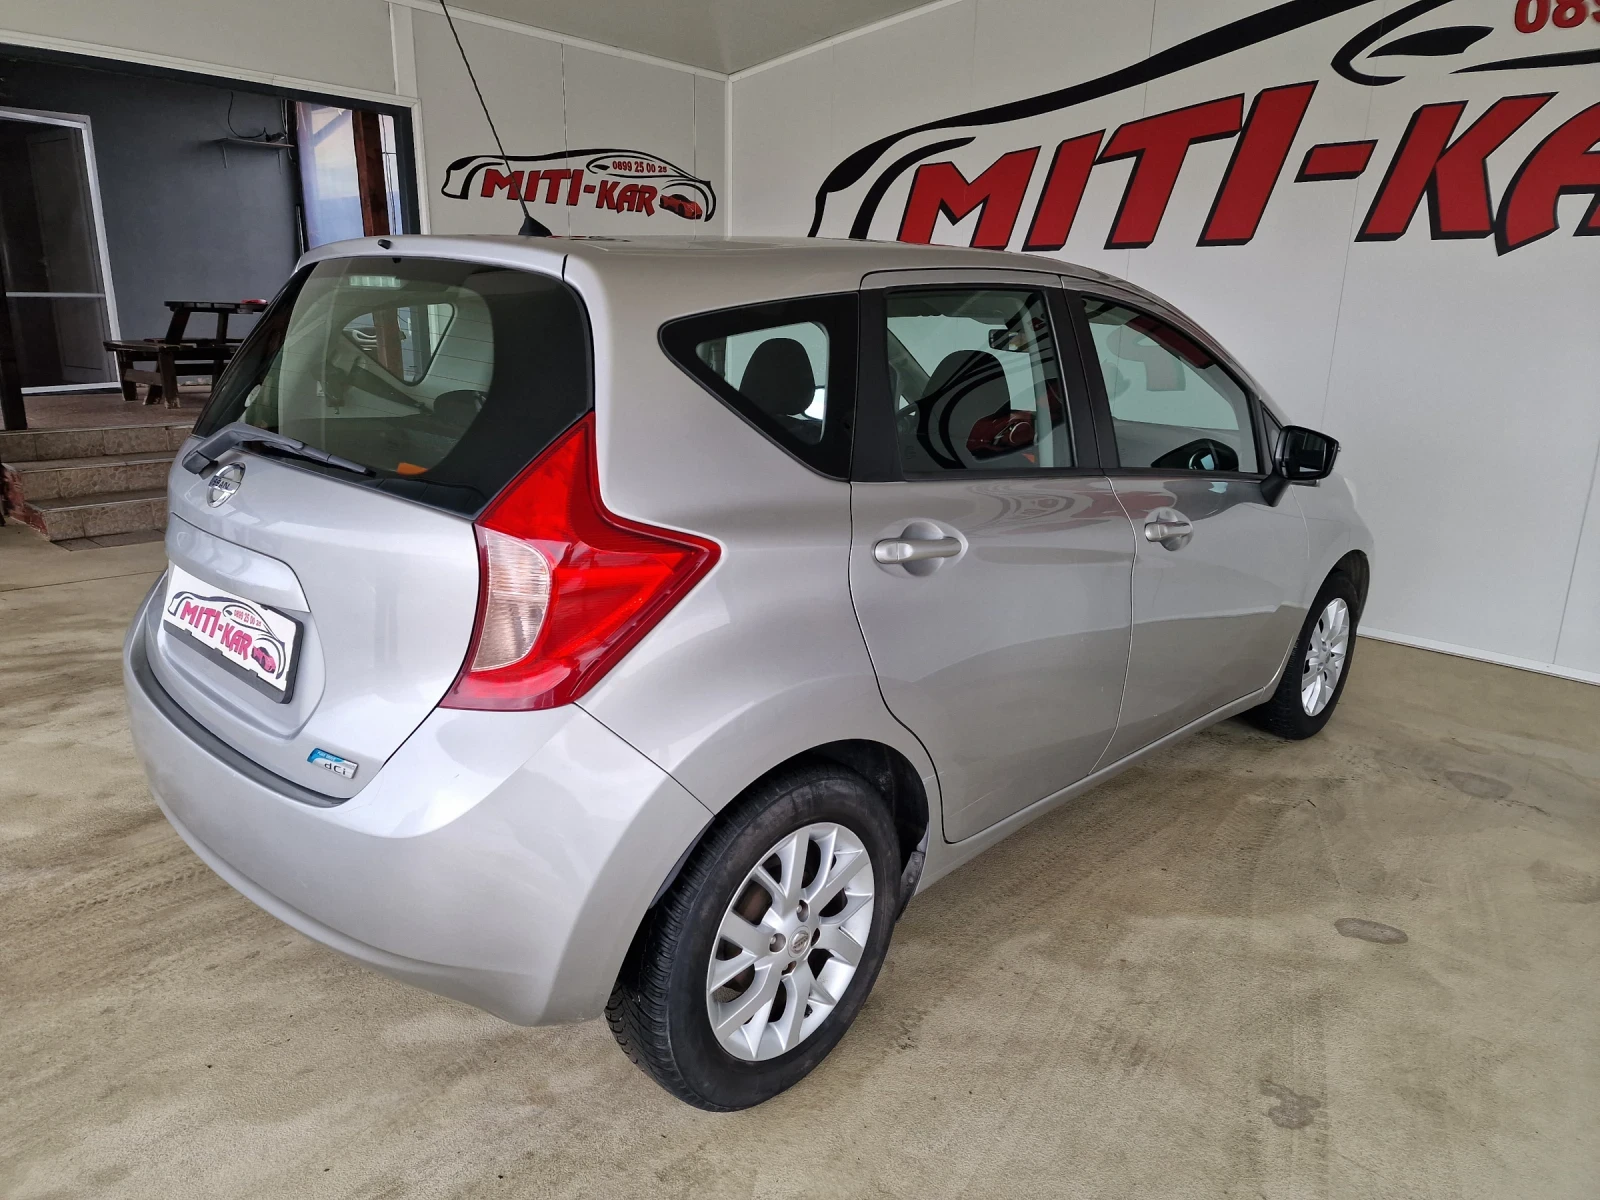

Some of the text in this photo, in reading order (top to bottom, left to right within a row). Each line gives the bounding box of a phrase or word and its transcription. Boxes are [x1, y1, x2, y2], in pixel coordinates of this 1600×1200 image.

[1514, 0, 1600, 33] 08
[612, 160, 668, 173] 0899 25 00 25
[480, 168, 658, 217] MITI-KAR
[180, 600, 253, 661] MITI-KAR
[324, 762, 346, 775] dCi
